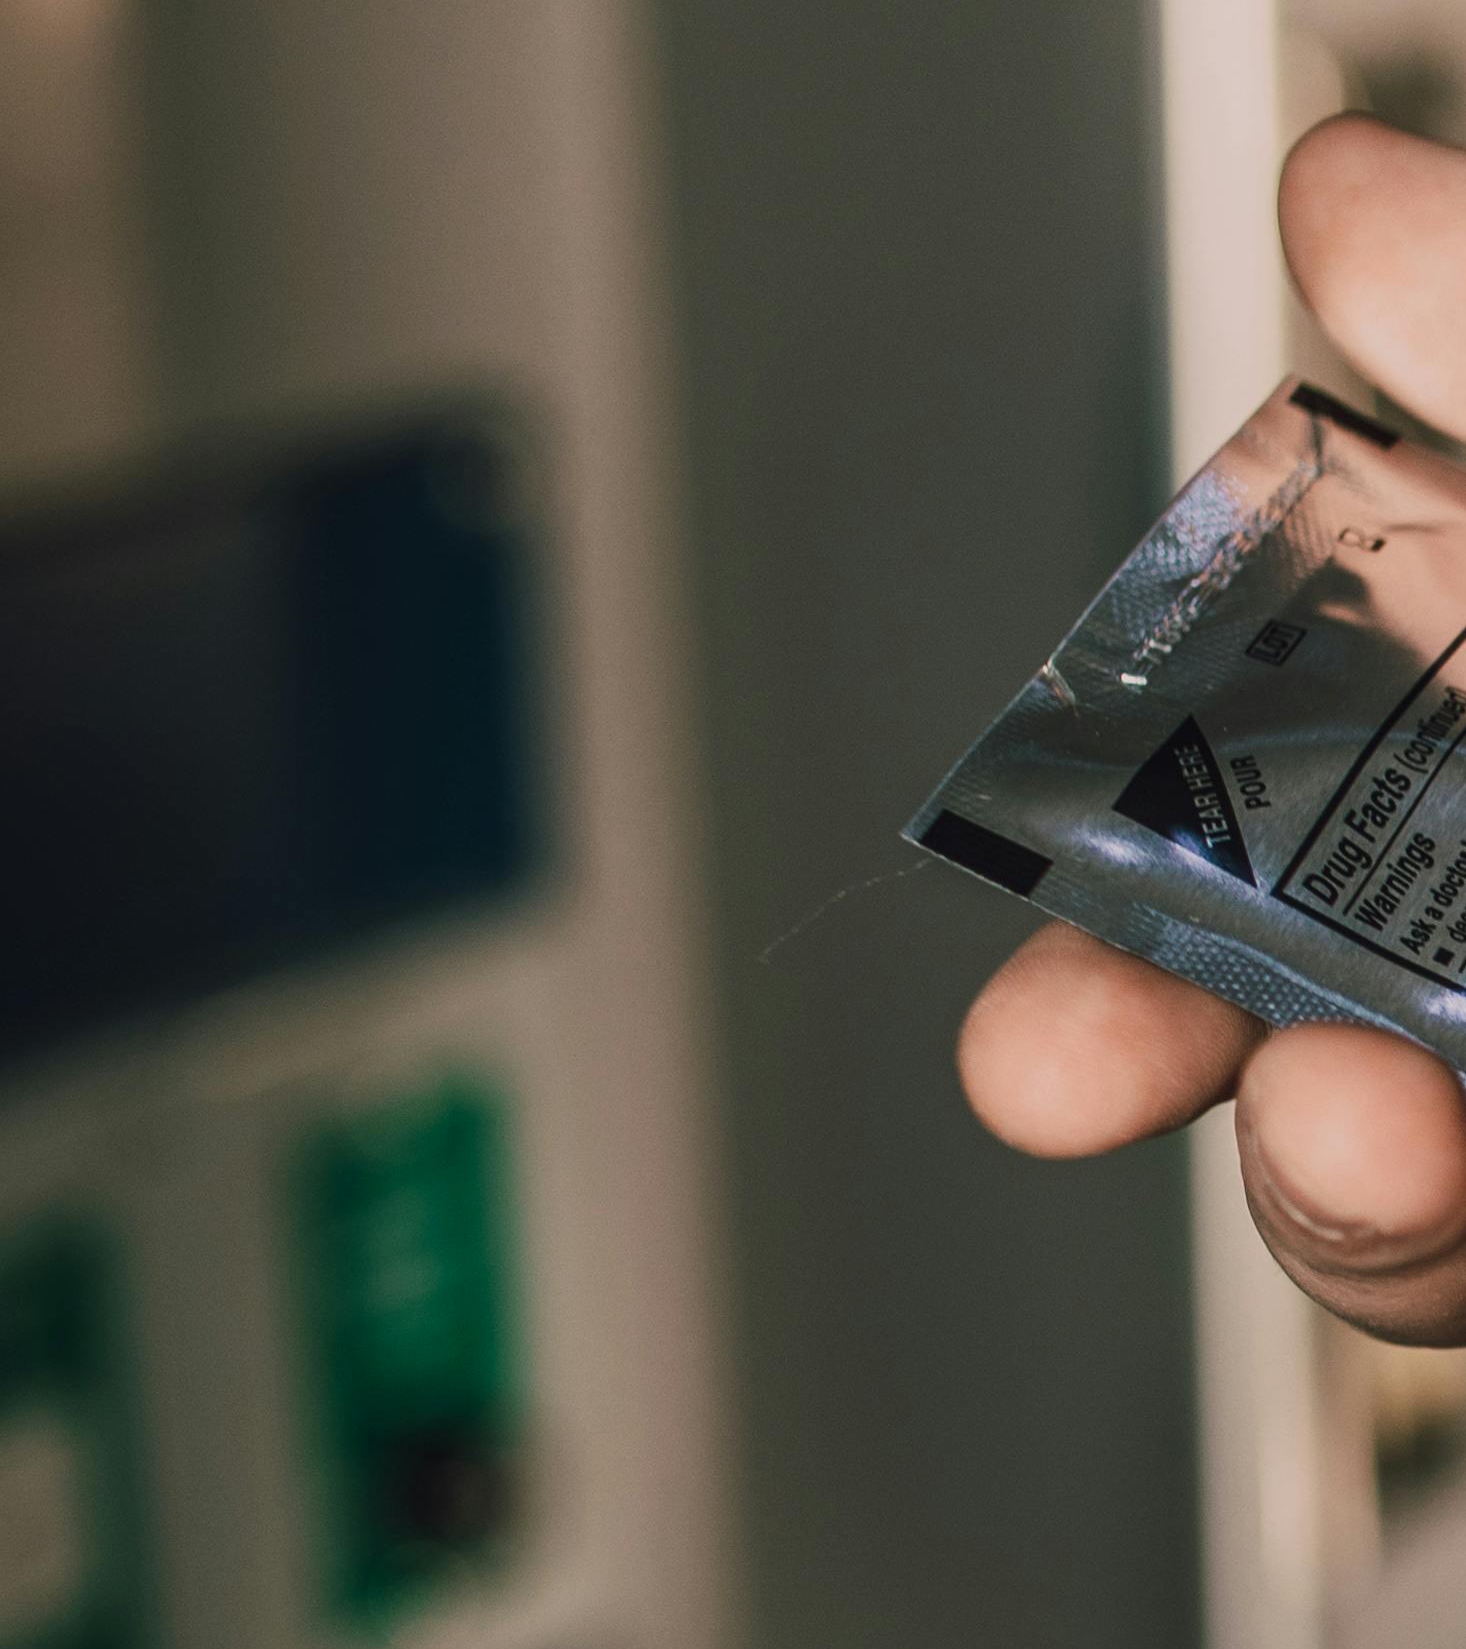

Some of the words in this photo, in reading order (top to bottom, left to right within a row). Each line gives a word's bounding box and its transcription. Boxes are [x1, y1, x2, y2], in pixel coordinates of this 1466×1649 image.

[1253, 624, 1295, 659] LOT
[1174, 743, 1211, 790] HERE
[1229, 755, 1273, 811] POUR
[1193, 793, 1231, 849] TEAR
[1301, 835, 1374, 908] Drug
[1342, 767, 1412, 845] Facts
[1353, 831, 1436, 933] Warnings
[1398, 917, 1438, 957] Ask
[1424, 905, 1445, 922] a
